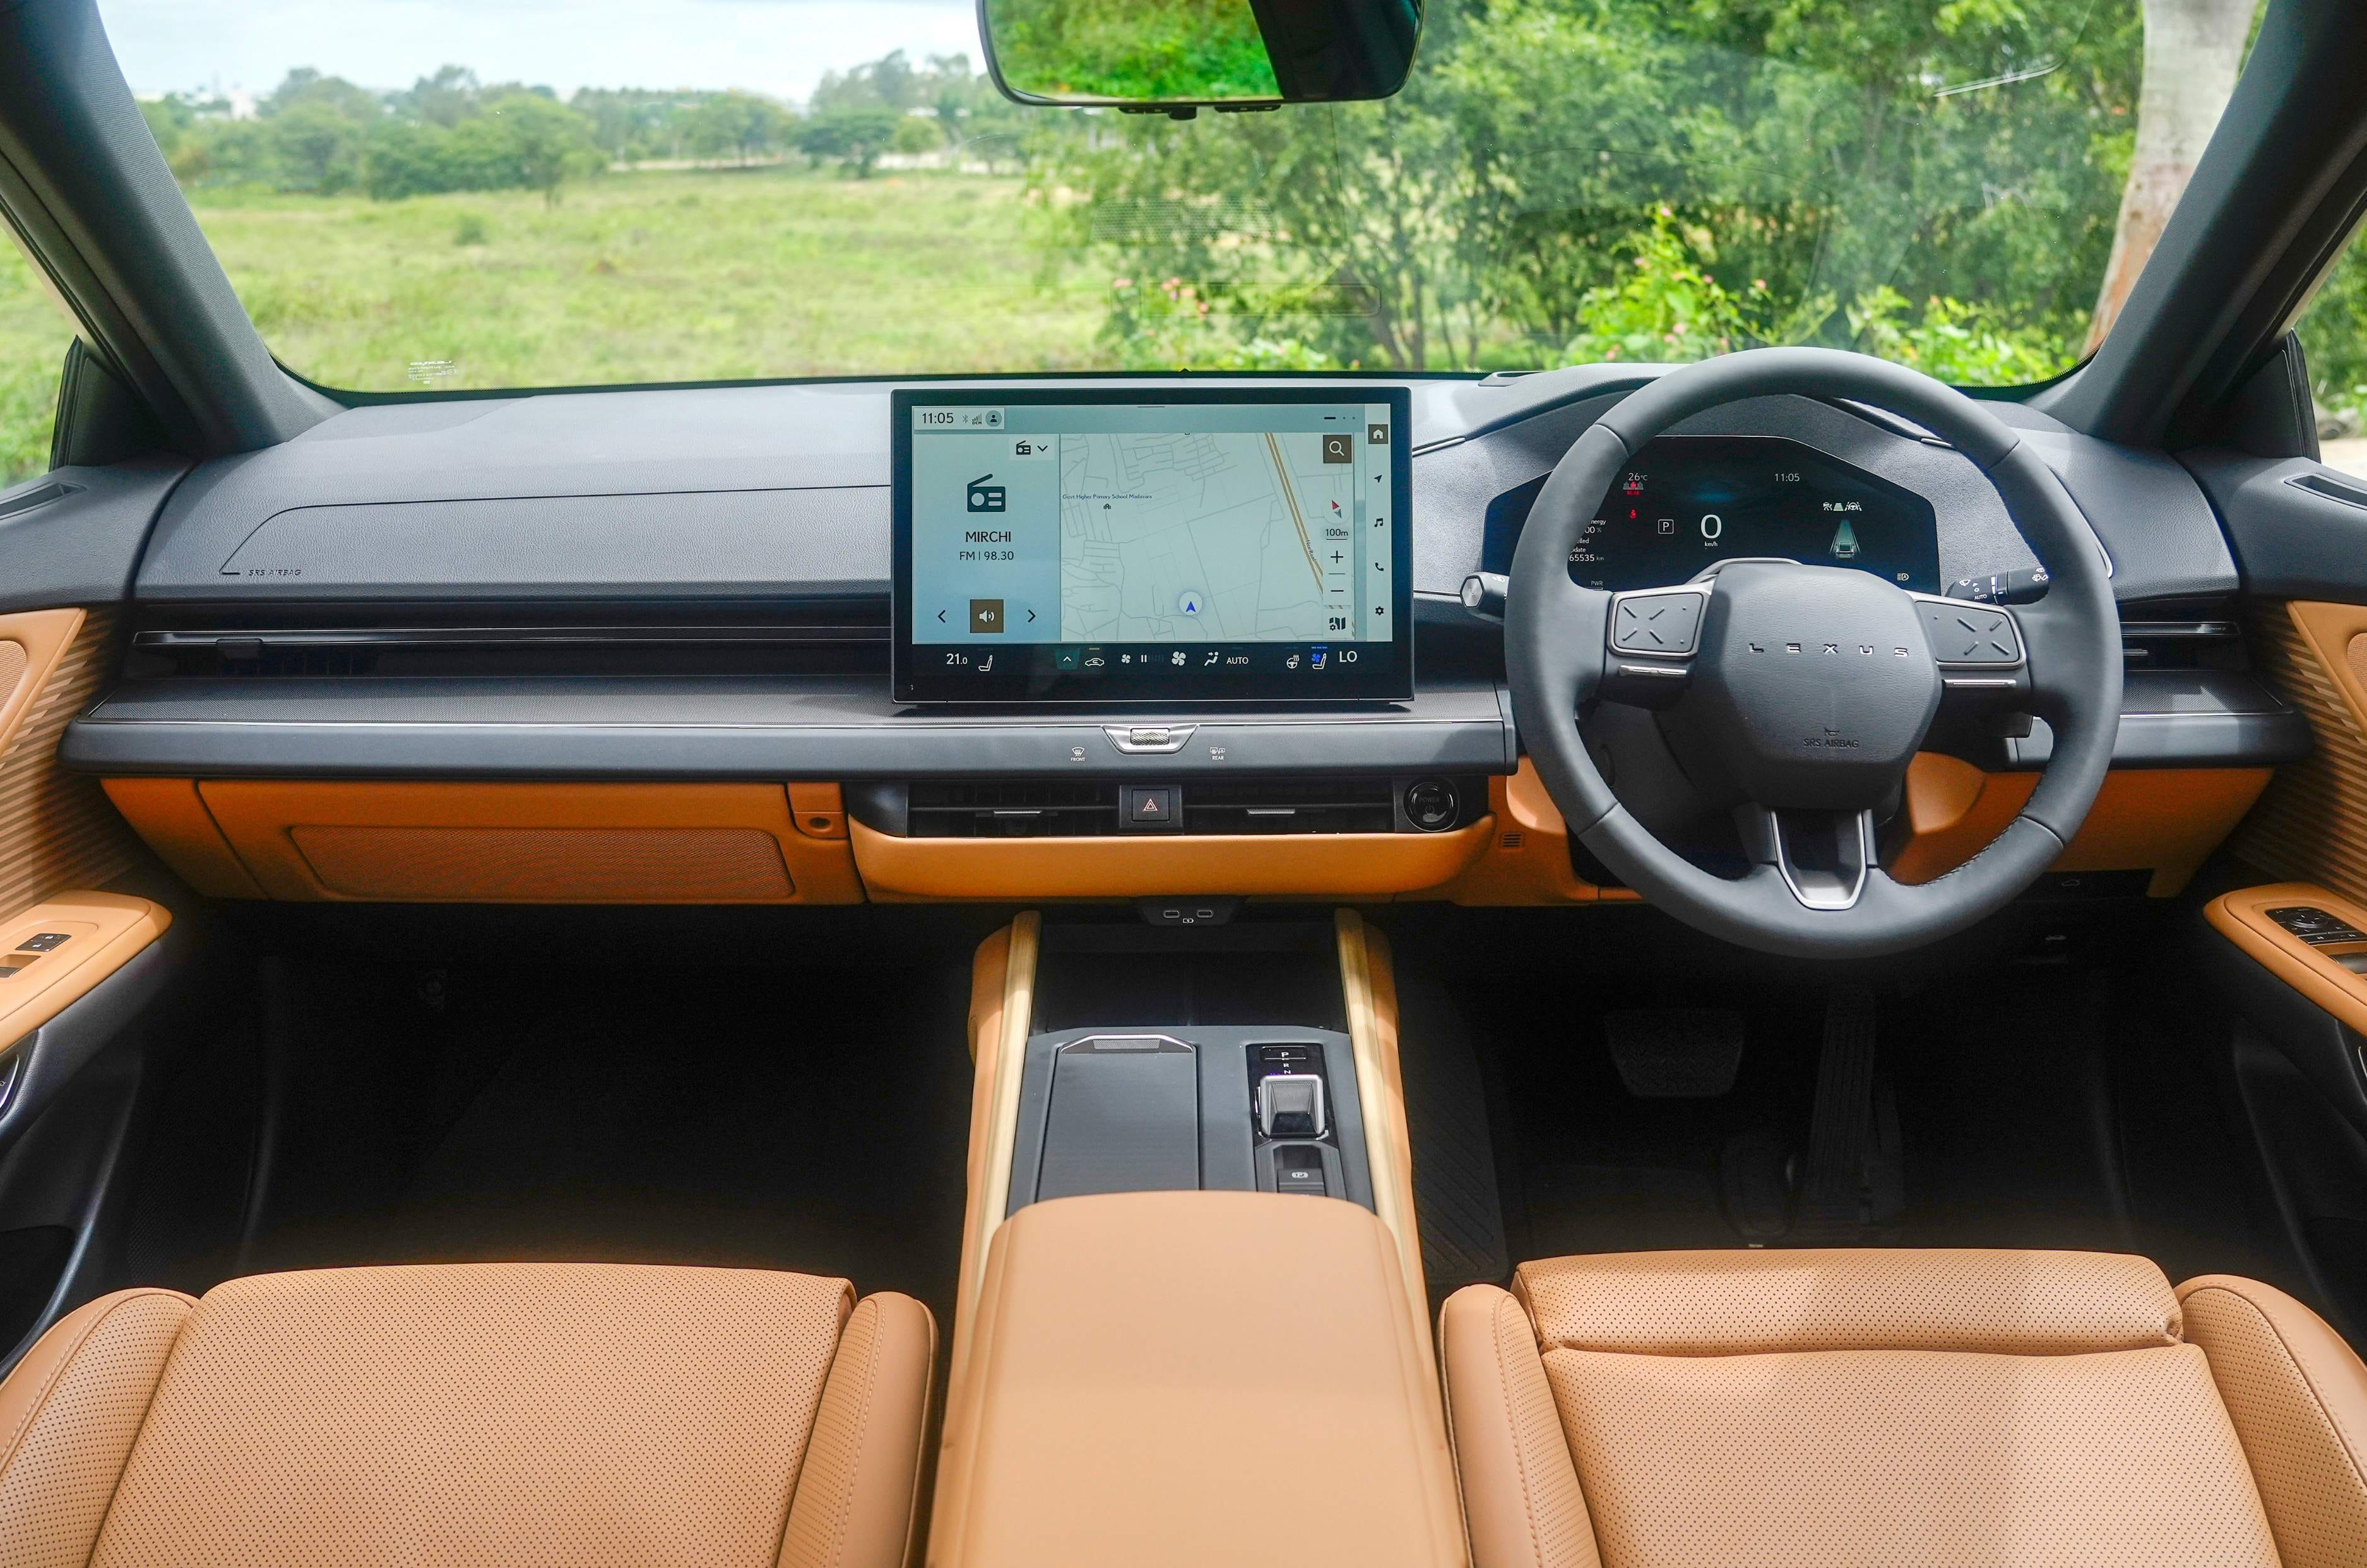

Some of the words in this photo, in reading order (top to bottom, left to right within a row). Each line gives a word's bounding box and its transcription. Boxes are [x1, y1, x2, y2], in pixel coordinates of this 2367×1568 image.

[922, 412, 954, 424] 11:05
[1774, 473, 1800, 482] 11:05
[1700, 514, 1722, 539] 0
[965, 531, 1011, 542] MIRCHI
[1326, 528, 1348, 537] 100m
[959, 551, 975, 561] FM
[984, 550, 1014, 561] 98.30
[1748, 643, 1909, 657] LEXUS
[946, 653, 968, 665] 21.0
[1226, 656, 1249, 665] AUTO
[1339, 651, 1358, 663] LO
[1803, 738, 1821, 747] SRS
[1824, 739, 1859, 749] AIRBAG
